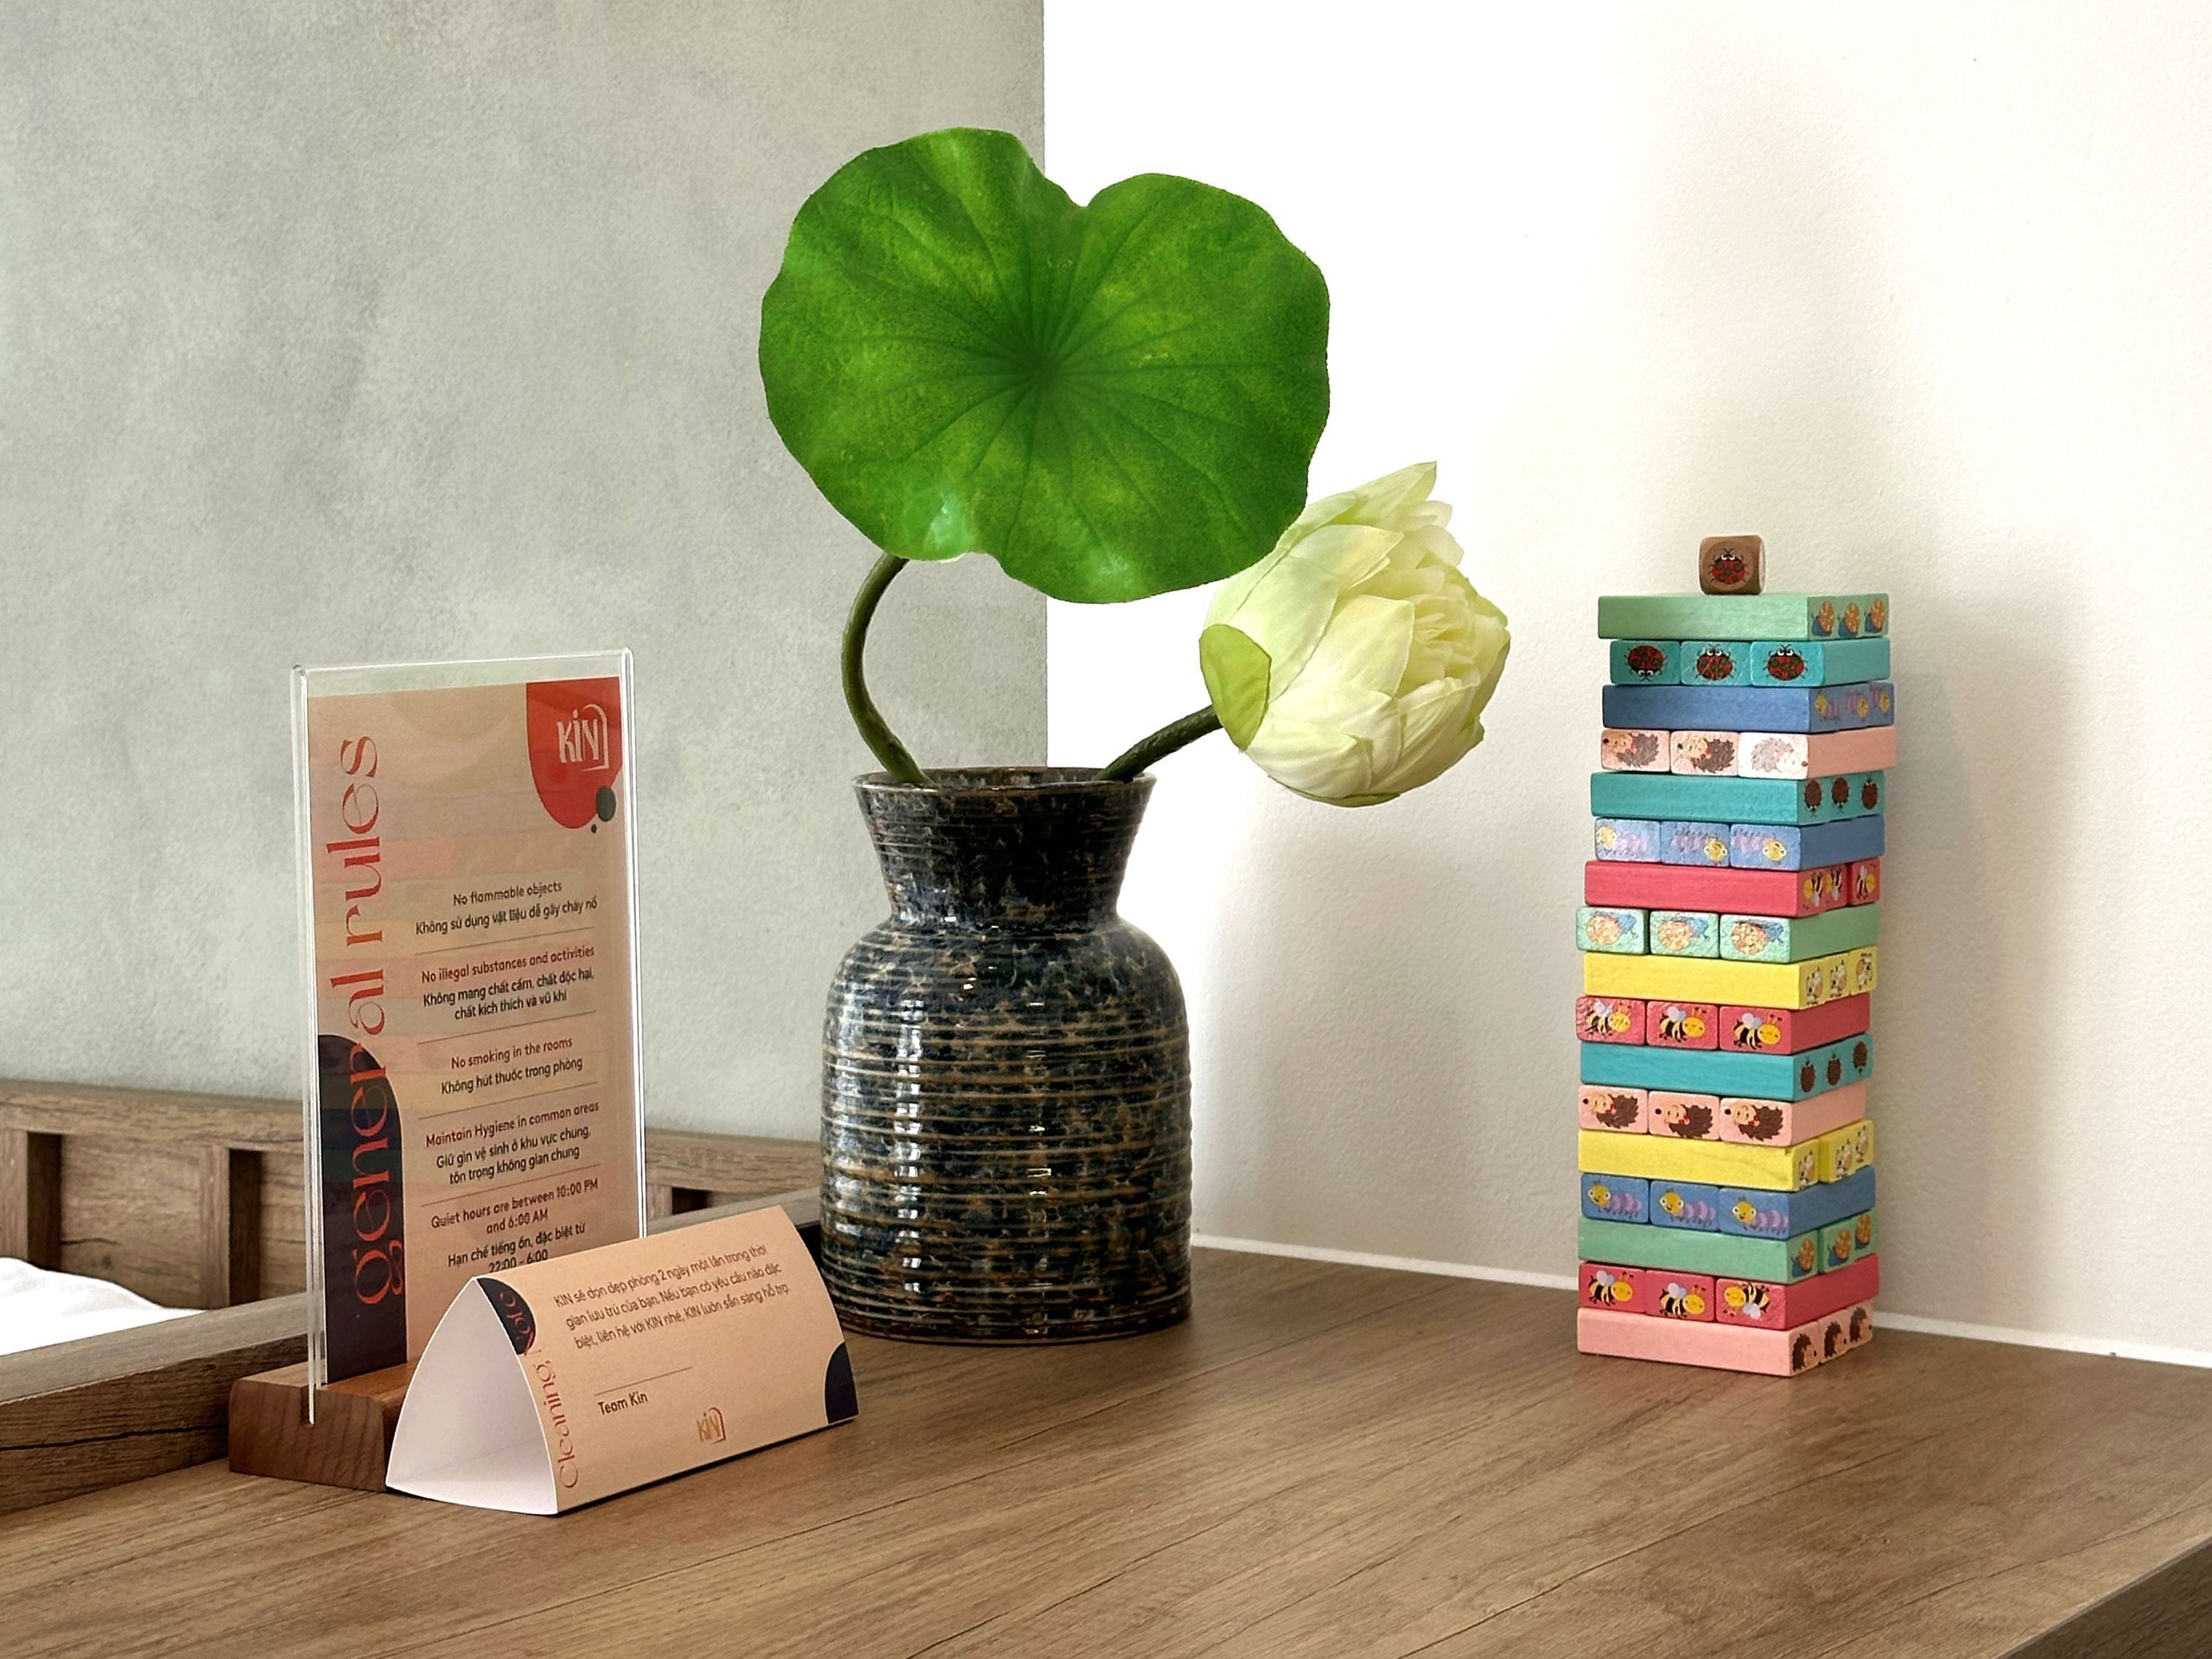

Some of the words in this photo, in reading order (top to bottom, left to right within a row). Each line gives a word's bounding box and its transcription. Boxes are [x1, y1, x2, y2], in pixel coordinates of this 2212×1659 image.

[326, 735, 383, 946] rules
[453, 894, 468, 906] No
[471, 885, 525, 904] flammable
[527, 881, 562, 897] objects
[422, 970, 436, 983] No
[439, 964, 469, 981] illegal
[473, 957, 527, 975] substances
[530, 951, 548, 966] and
[550, 945, 595, 962] activities
[458, 988, 485, 1002] mang
[452, 1056, 465, 1070] No
[468, 1048, 510, 1067] smoking
[513, 1045, 522, 1058] in
[525, 1043, 541, 1055] the
[544, 1038, 573, 1052] rooms
[525, 1064, 550, 1078] trong
[330, 969, 403, 1304] general
[426, 1126, 472, 1148] Maintain
[475, 1120, 515, 1140] Hygiene
[518, 1115, 527, 1128] in
[529, 1108, 571, 1125] common
[574, 1102, 600, 1115] areas
[490, 1141, 509, 1156] sinh
[521, 1136, 538, 1151] khu
[529, 1153, 549, 1169] gian
[552, 1147, 580, 1162] chung
[431, 1212, 460, 1228] Quiet
[463, 1206, 490, 1221] hours
[493, 1202, 509, 1214] are
[512, 1191, 554, 1209] between
[557, 1183, 582, 1199] 10:00
[584, 1177, 598, 1191] PM
[487, 1219, 505, 1234] and
[508, 1213, 530, 1228] 6:00
[533, 1208, 549, 1222] AM
[527, 1249, 548, 1264] 6:00
[554, 1292, 573, 1307] KIN
[726, 1250, 751, 1262] trong
[566, 1314, 588, 1331] gian
[645, 1315, 664, 1331] KIN
[684, 1306, 701, 1320] KIN
[598, 1398, 628, 1415] Team
[629, 1391, 648, 1407] Kin
[533, 1360, 579, 1489] Cleaning
